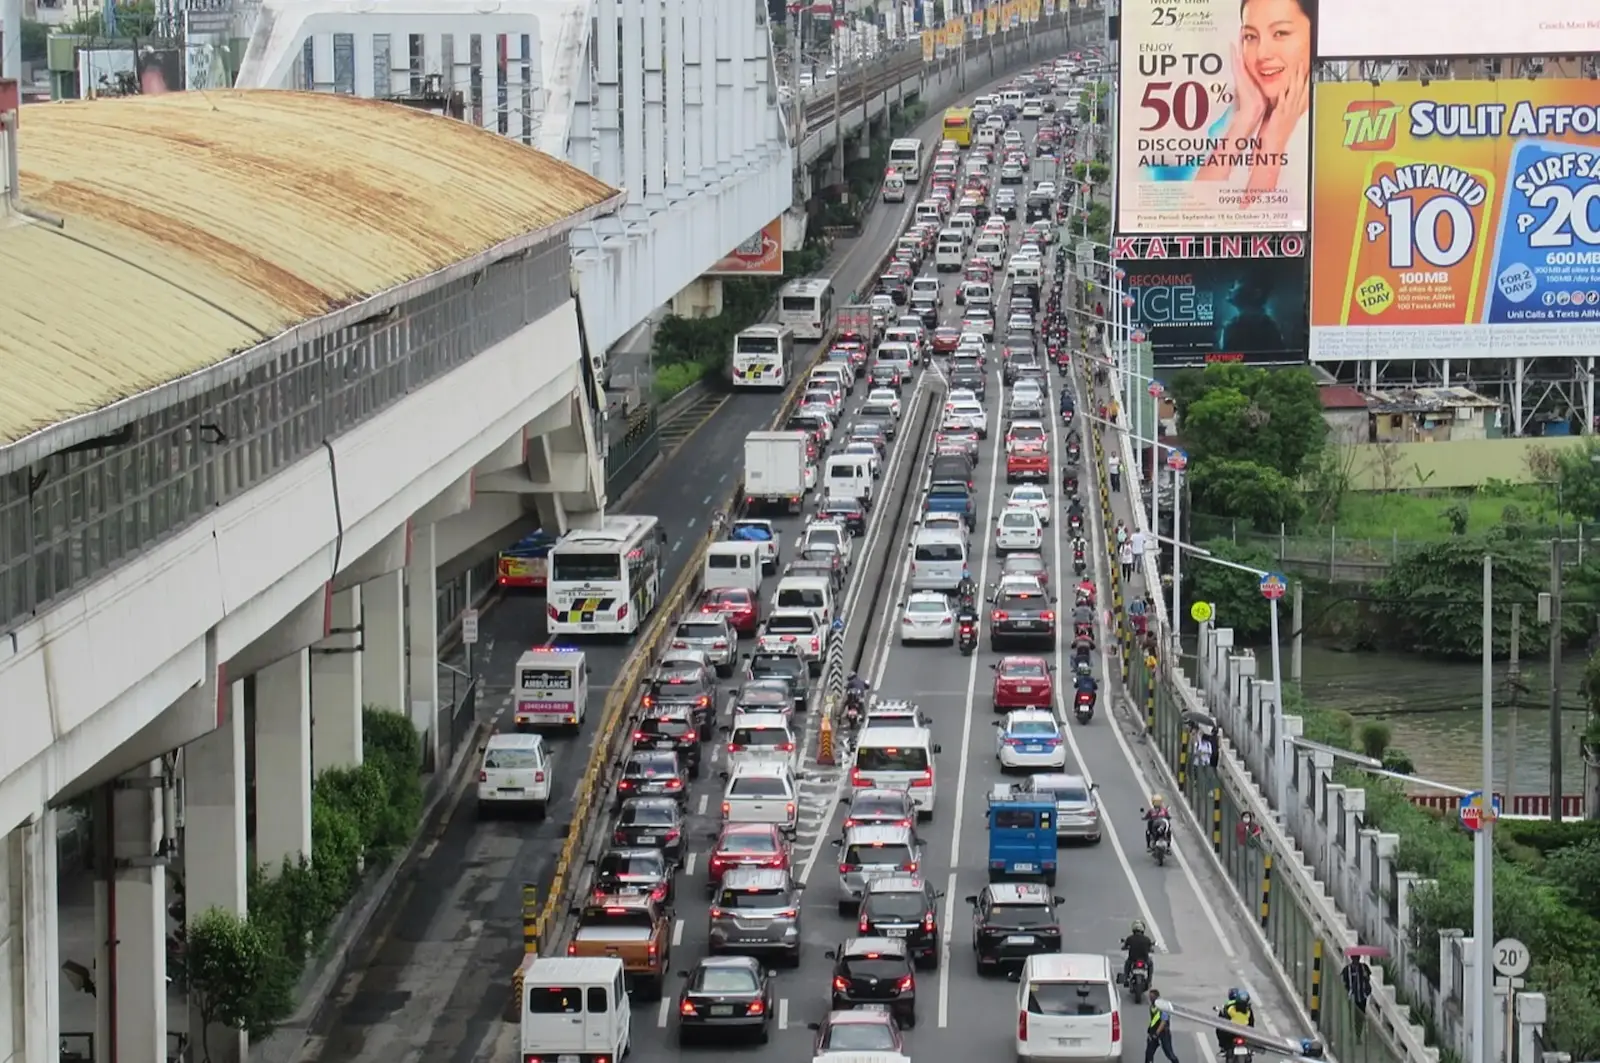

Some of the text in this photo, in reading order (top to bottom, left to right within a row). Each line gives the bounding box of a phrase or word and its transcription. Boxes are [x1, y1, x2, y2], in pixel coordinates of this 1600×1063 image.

[1151, 7, 1212, 28] 25 years
[1139, 43, 1173, 52] ENJOY
[1139, 53, 1223, 76] UP TO
[1342, 106, 1404, 147] TNT
[1410, 101, 1600, 137] SULIT AFFO
[1138, 138, 1263, 151] DISCOUNT ON
[1138, 153, 1289, 168] ALL TREATMENTS
[1365, 163, 1487, 208] PANTAWID
[1182, 213, 1215, 221] September
[1116, 234, 1304, 260] KATINKO
[1129, 274, 1192, 286] BECOMING
[1501, 270, 1531, 286] FOR 2
[1360, 282, 1384, 296] FOR
[1504, 281, 1532, 295] DAYS
[1129, 286, 1196, 322] ICE
[1507, 311, 1524, 319] Unli
[524, 680, 569, 688] AMBULANCE
